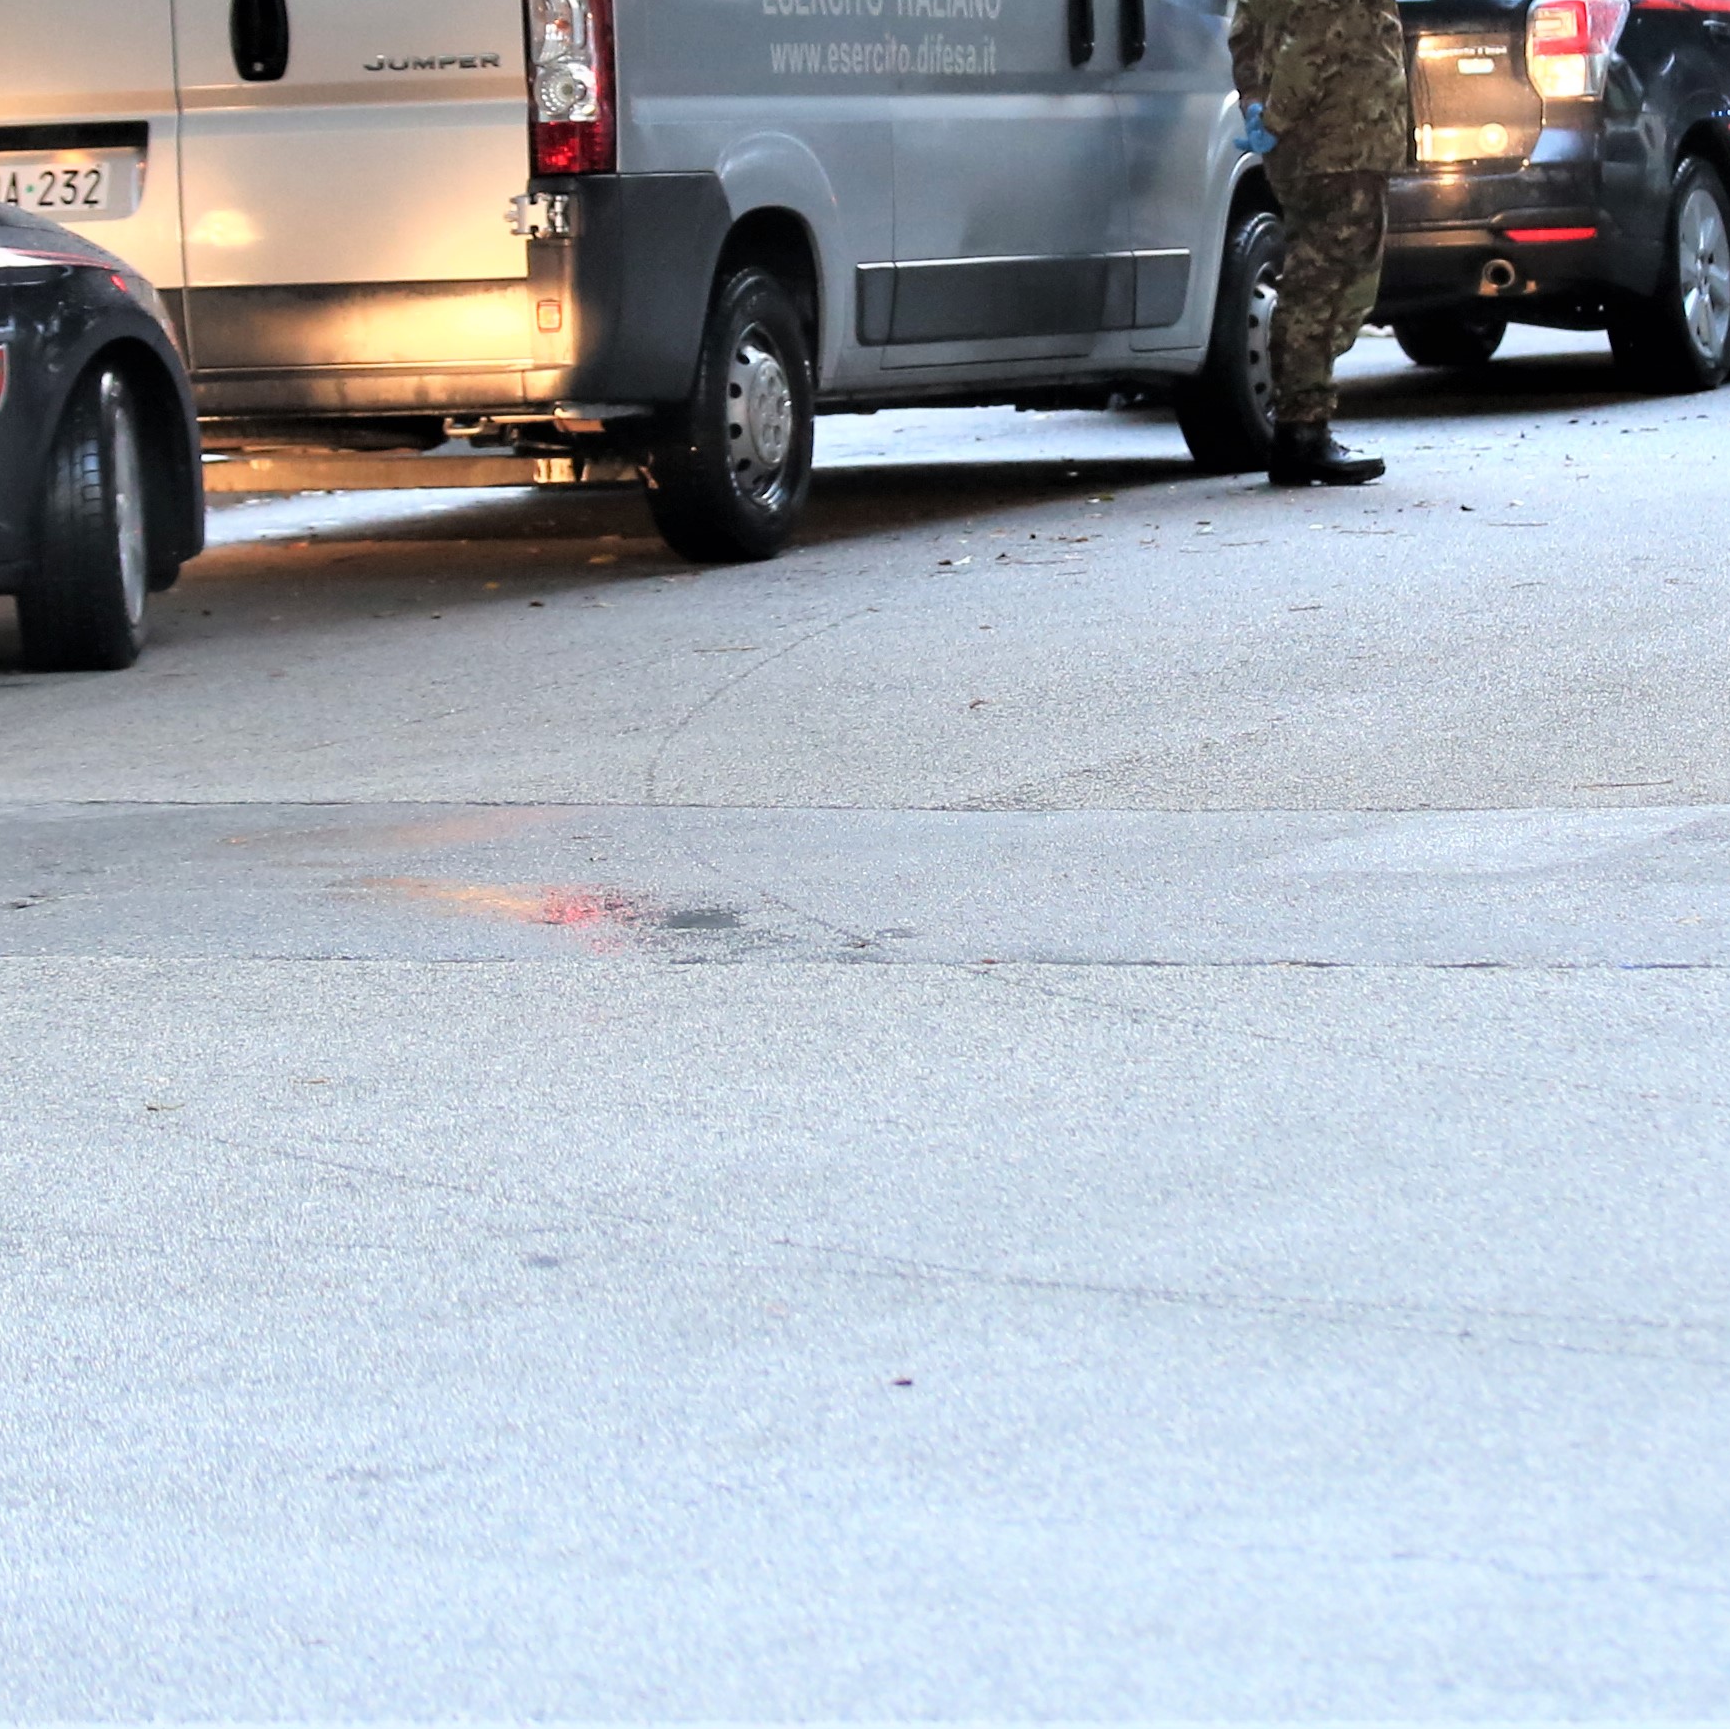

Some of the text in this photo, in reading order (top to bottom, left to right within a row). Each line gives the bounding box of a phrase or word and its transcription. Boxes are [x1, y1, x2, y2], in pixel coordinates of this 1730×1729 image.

[363, 53, 501, 72] JUMPER
[770, 32, 998, 76] www.esercito.difesa.it
[37, 169, 103, 208] 232
